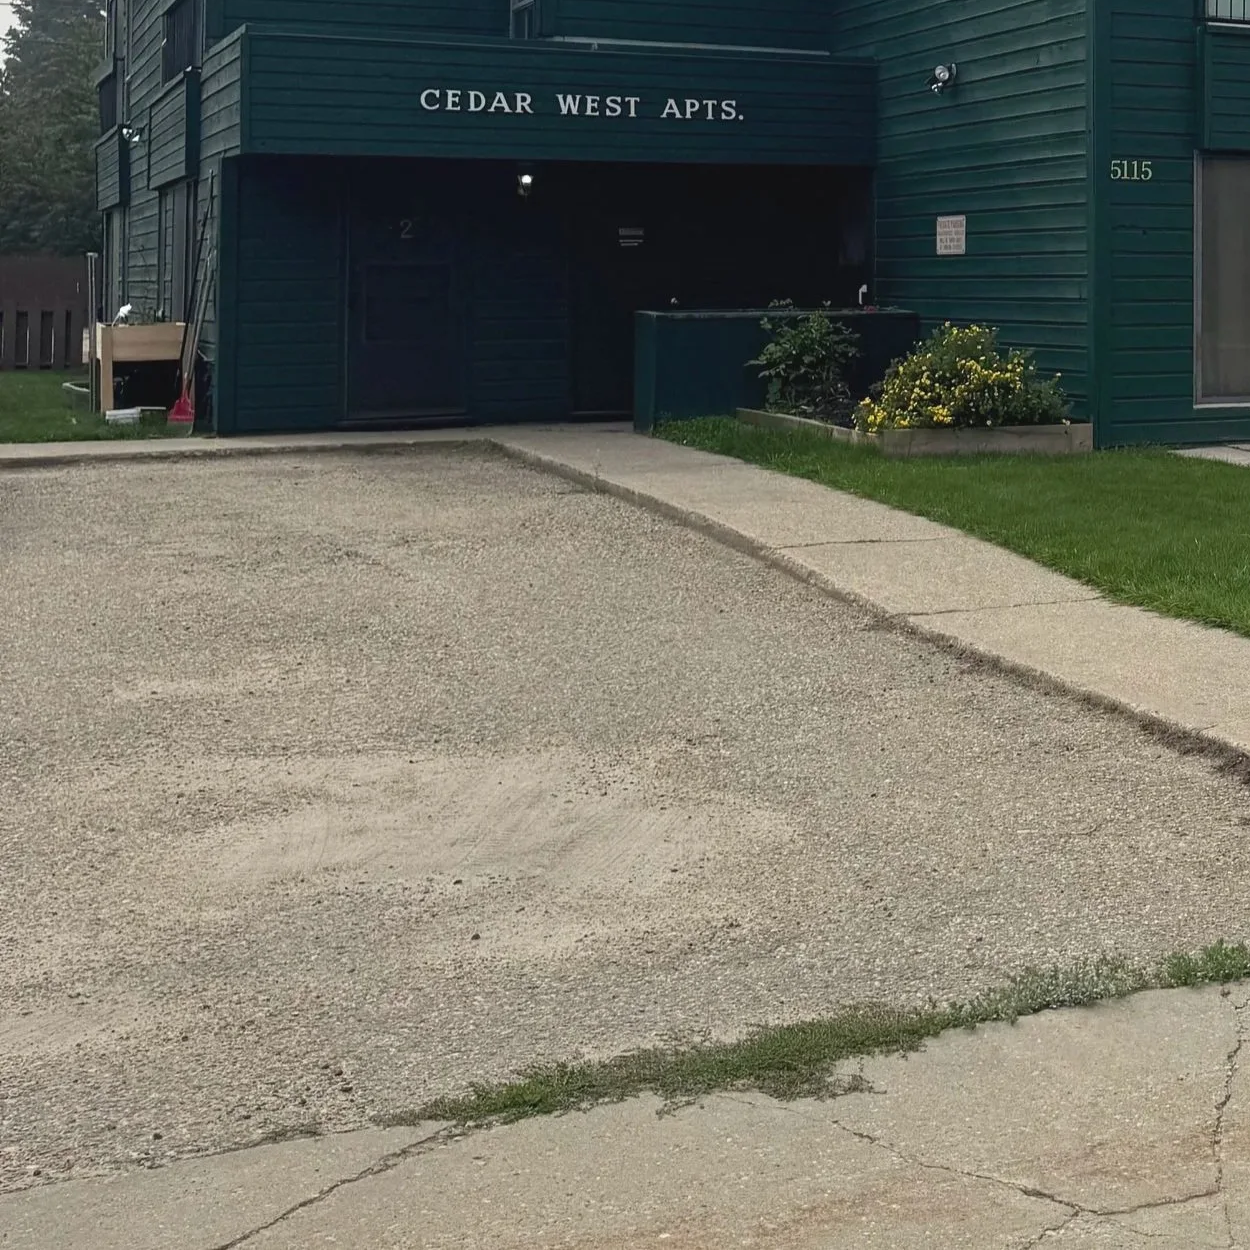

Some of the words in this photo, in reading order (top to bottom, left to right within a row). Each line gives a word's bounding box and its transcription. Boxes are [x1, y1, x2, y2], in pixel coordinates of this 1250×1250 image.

[420, 88, 534, 114] CEDAR
[555, 93, 640, 118] WEST
[659, 98, 744, 121] APTS.
[1110, 160, 1153, 180] 5115
[400, 219, 413, 239] 2
